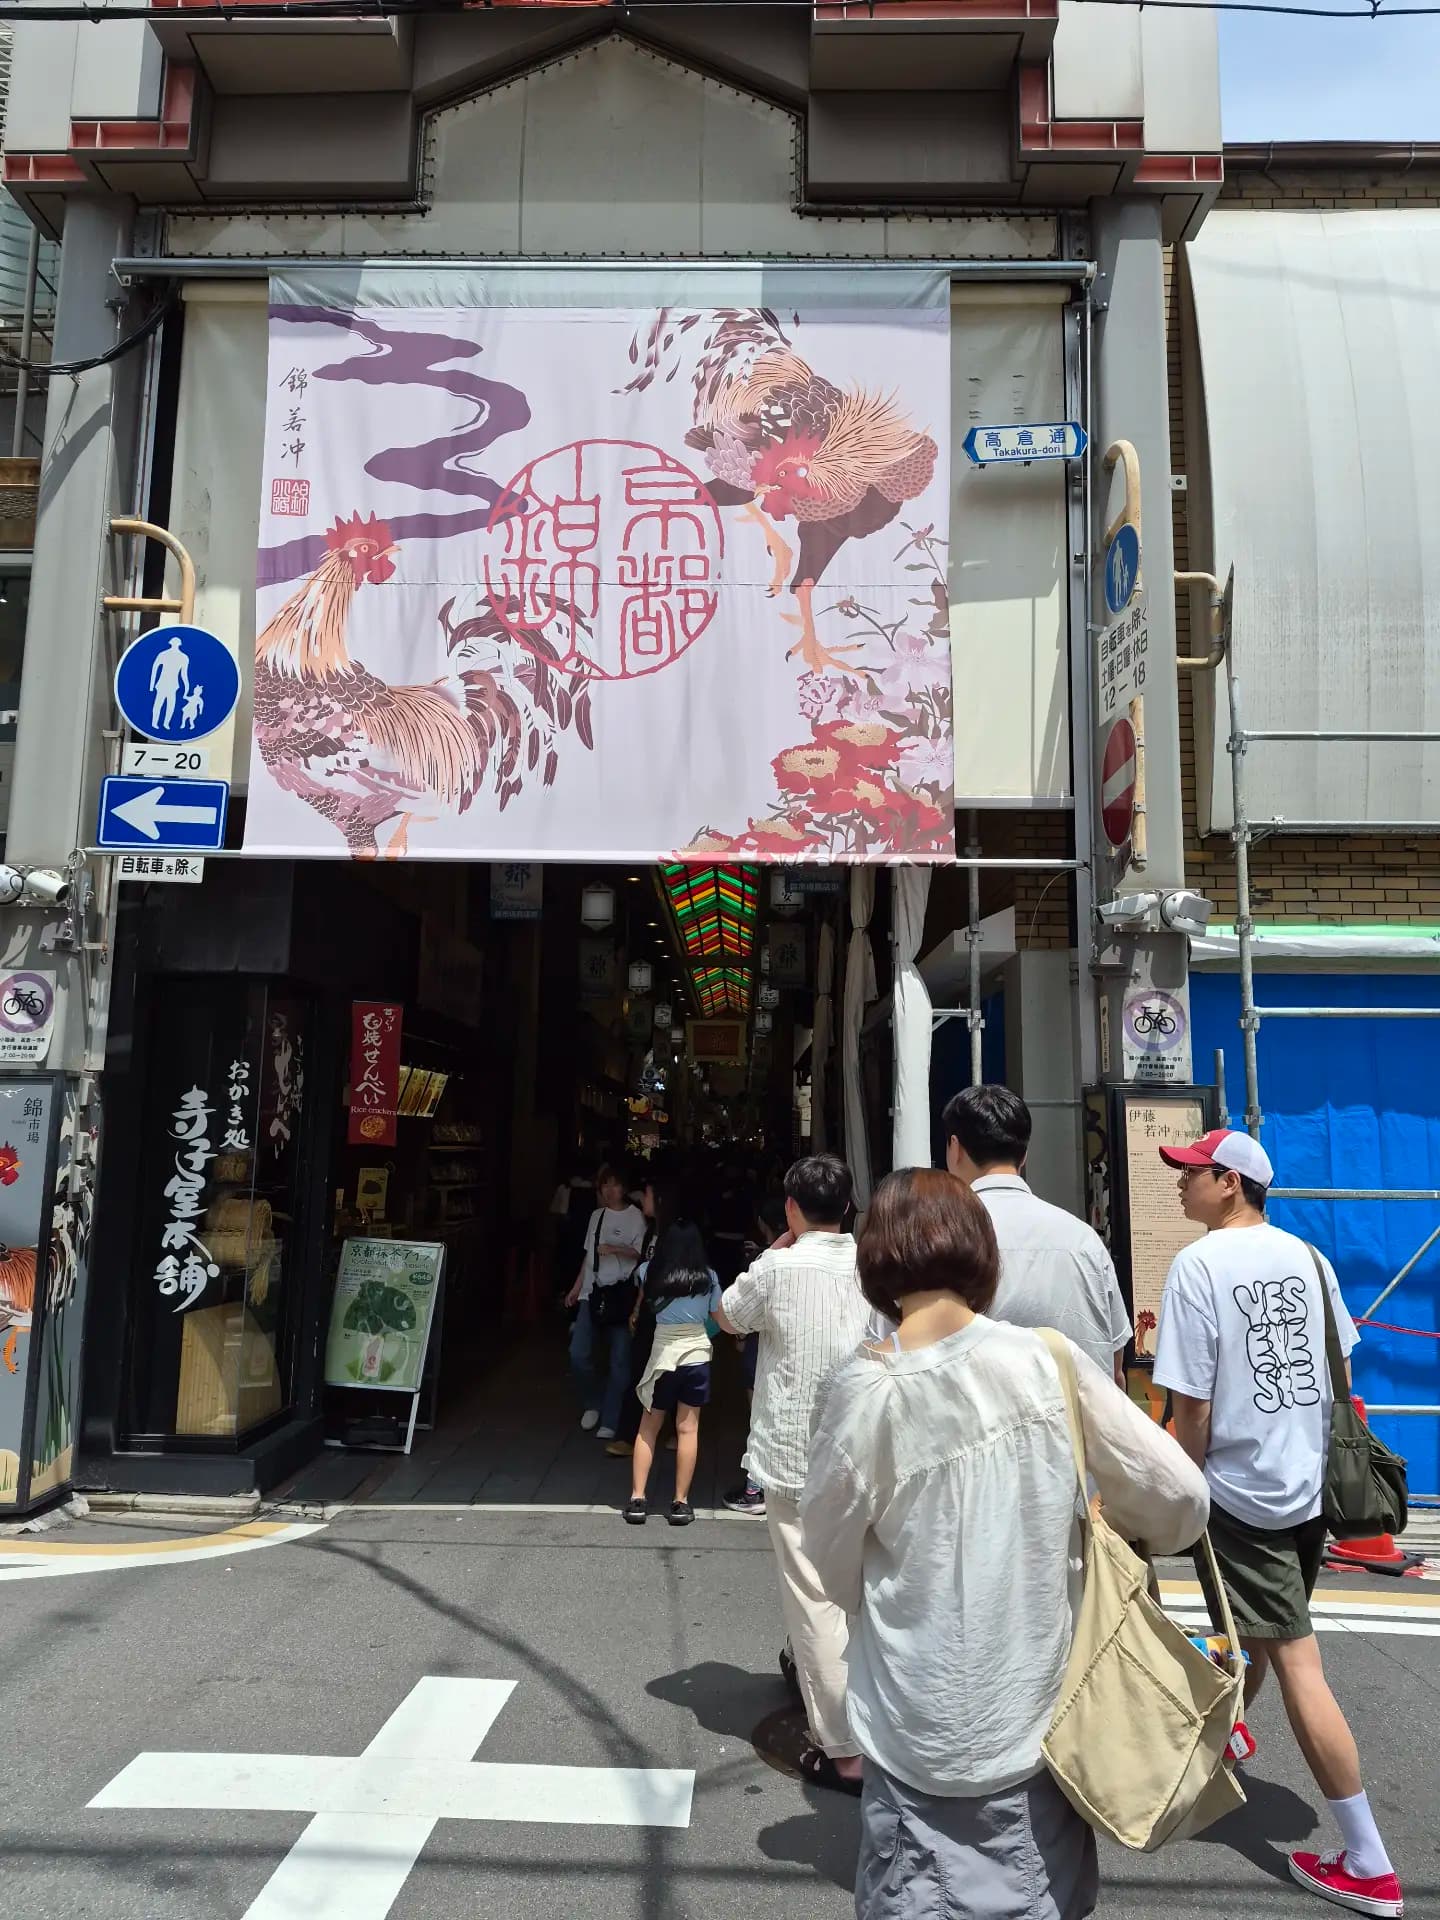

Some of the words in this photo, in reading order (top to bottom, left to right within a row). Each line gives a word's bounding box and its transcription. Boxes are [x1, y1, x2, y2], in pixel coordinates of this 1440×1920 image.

[984, 428, 1066, 449] 高倉通
[993, 445, 1061, 457] Takakura-dori
[1101, 607, 1148, 662] 自転車を除く
[121, 856, 199, 876] 自転車を除く
[219, 1060, 250, 1151] おかき処
[351, 1105, 367, 1113] Rice
[1129, 1109, 1156, 1122] 伊藤
[23, 1097, 43, 1143] 錦市場
[1144, 1123, 1170, 1137] 若冲
[1233, 1276, 1309, 1331] YES
